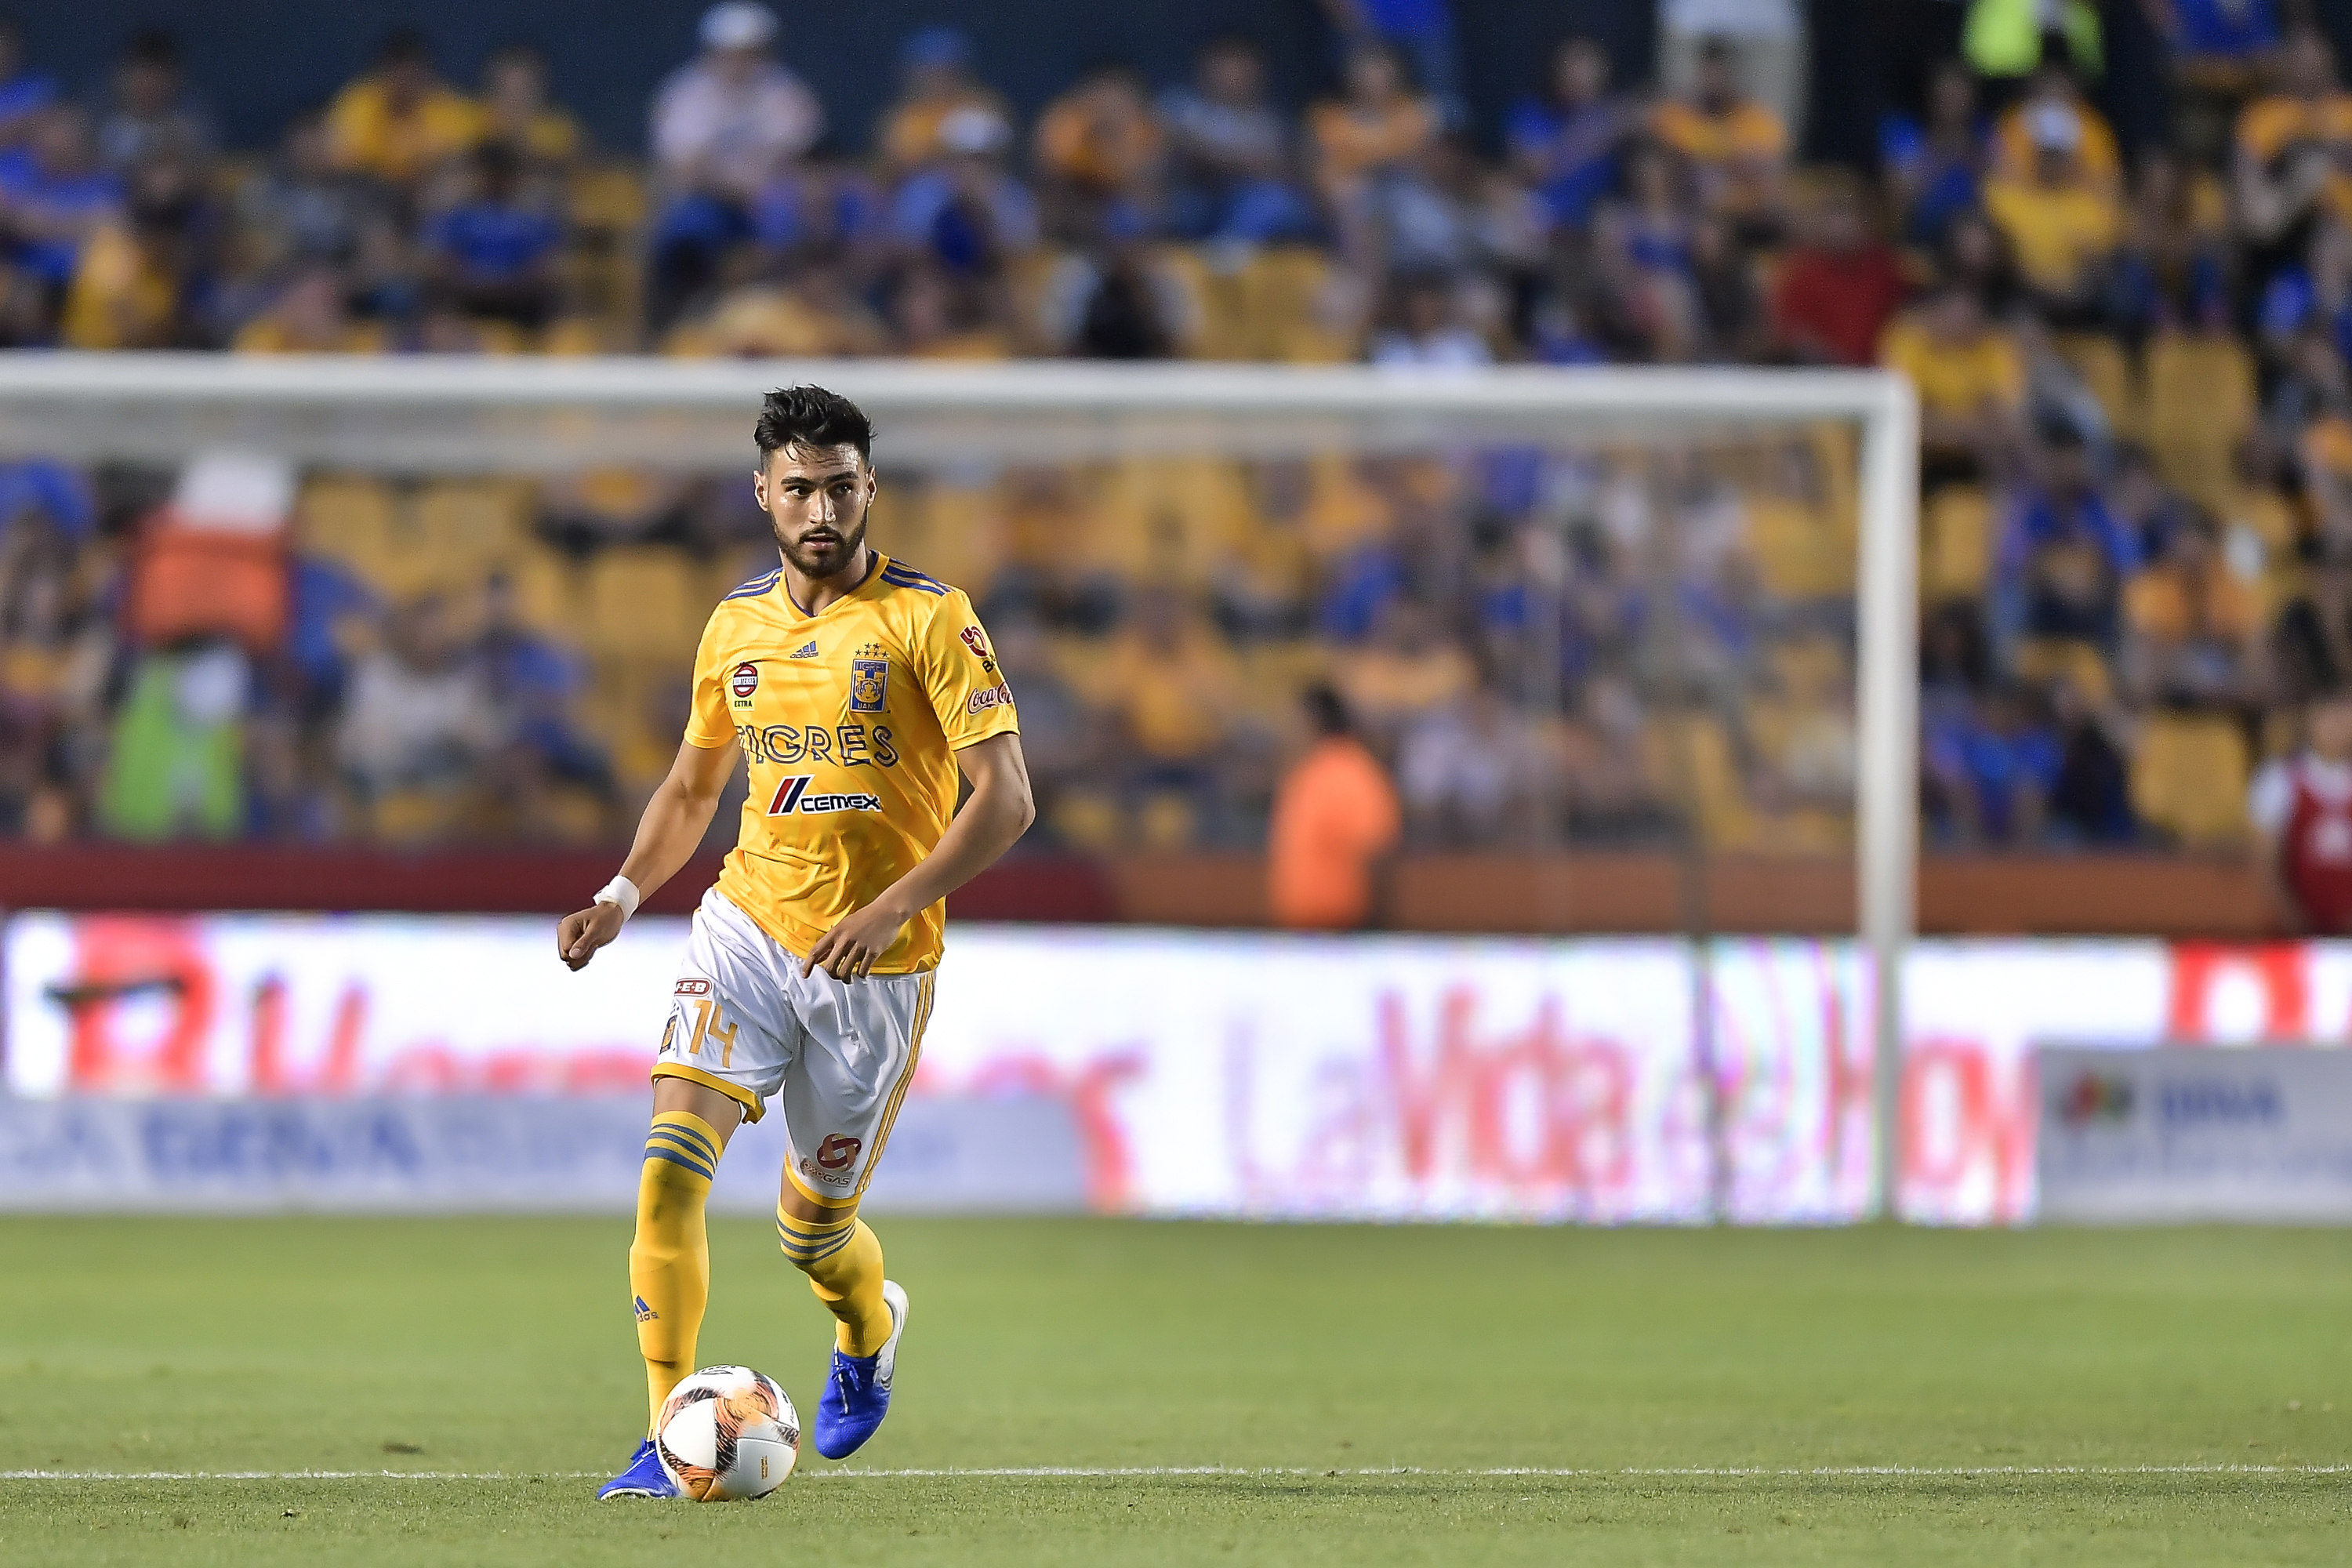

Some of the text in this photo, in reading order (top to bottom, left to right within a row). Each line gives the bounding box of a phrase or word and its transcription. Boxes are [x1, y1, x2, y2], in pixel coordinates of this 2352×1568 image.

[734, 699, 753, 708] EXTRA
[800, 795, 882, 812] CEMEX
[688, 999, 739, 1069] 14
[823, 1173, 851, 1186] GAS
